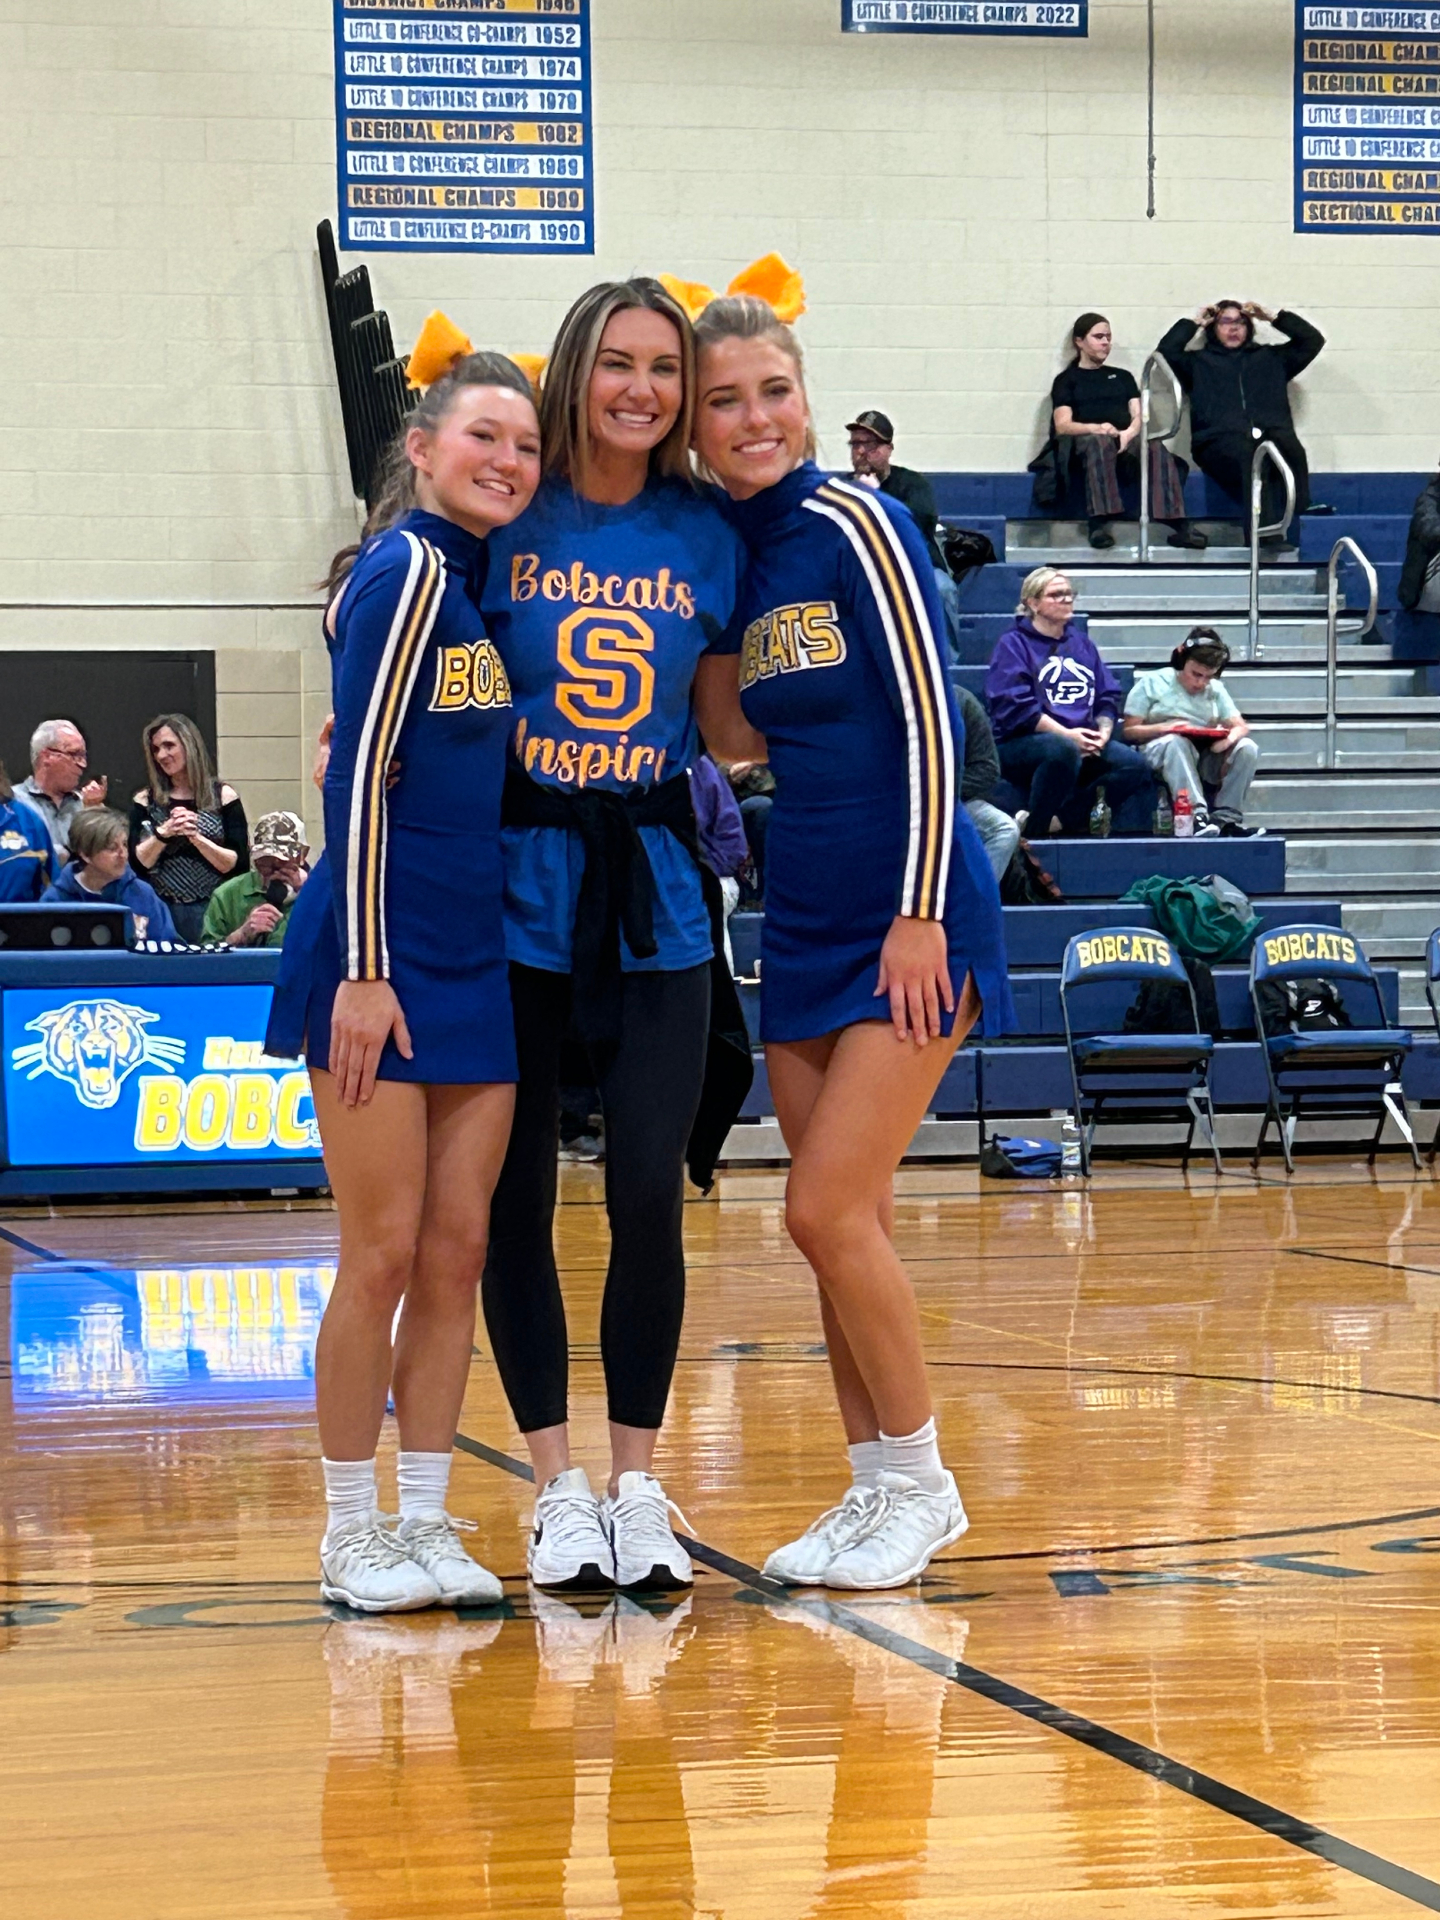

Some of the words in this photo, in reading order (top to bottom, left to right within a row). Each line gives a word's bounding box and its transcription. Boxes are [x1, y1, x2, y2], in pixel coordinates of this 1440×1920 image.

[857, 3, 891, 20] LITTLE
[911, 3, 978, 22] CONFERENCE
[983, 5, 1028, 23] CHAMPS
[1036, 6, 1075, 23] 2022
[1309, 10, 1342, 27] LITTLE
[1361, 11, 1426, 29] CONFERENCE
[350, 22, 382, 40] LITTLE
[401, 23, 463, 42] CONFERENCE
[467, 24, 527, 44] CO-CHAMPS
[536, 26, 576, 44] 1952
[1308, 42, 1386, 60] REGIONAL
[1393, 43, 1440, 61] CHAM
[350, 54, 386, 73] LITTLE
[407, 55, 477, 75] CONFERENCE
[482, 57, 527, 77] CHAMPS
[539, 58, 576, 77] 1974
[1308, 74, 1386, 92] REGIONAL
[1393, 75, 1440, 93] CHAM
[351, 88, 386, 107] LITTLE
[408, 88, 477, 109] CONFERENCE
[483, 90, 528, 110] CHAMPS
[1308, 107, 1341, 124] LITTLE
[1360, 108, 1426, 126] CONFERENCE
[351, 121, 437, 140] REGIONAL
[443, 122, 515, 141] CHAMPS
[1308, 138, 1341, 156] LITTLE
[1360, 140, 1426, 158] CONFERENCE
[353, 155, 388, 172] LITTLE
[410, 155, 480, 174] CONFERENCE
[484, 155, 529, 174] CHAMPS
[539, 158, 578, 176] 1989
[1308, 171, 1386, 189] REGIONAL
[1393, 172, 1440, 190] CHAM
[353, 187, 437, 206] REGIONAL
[445, 188, 516, 207] CHAMPS
[1308, 203, 1396, 221] SECTIONAL
[354, 220, 386, 238] LITTLE
[405, 221, 468, 239] CONFERENCE
[472, 222, 531, 241] CO-CHAMPS
[540, 223, 580, 241] 1990
[510, 553, 695, 620] Bobcats
[555, 606, 656, 732] S
[1076, 934, 1172, 968] BOBCATS
[1264, 932, 1357, 966] BOBCATS
[134, 1071, 323, 1151] BOBC
